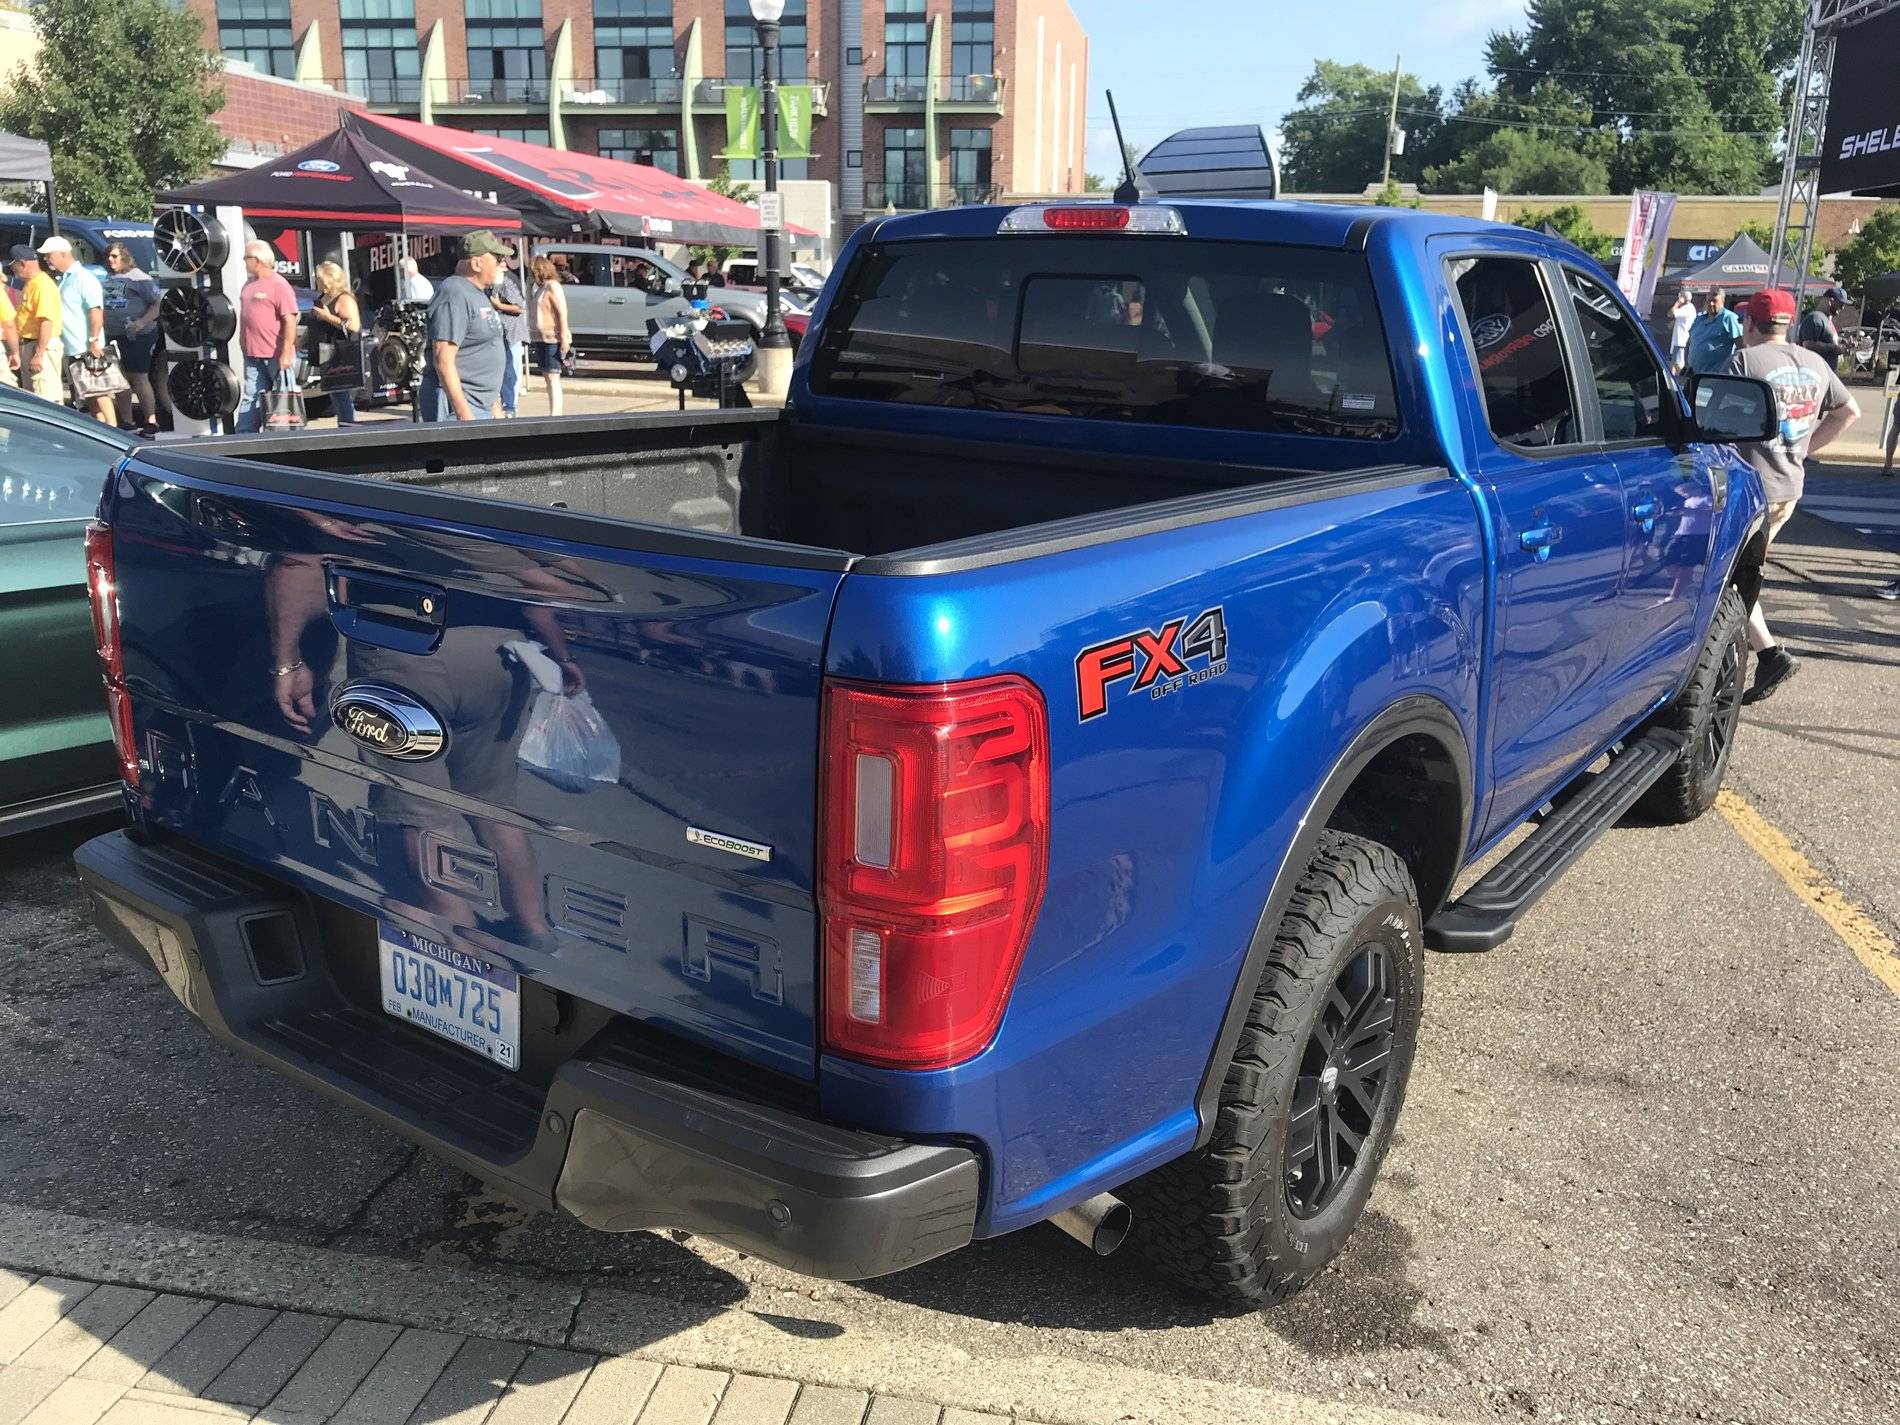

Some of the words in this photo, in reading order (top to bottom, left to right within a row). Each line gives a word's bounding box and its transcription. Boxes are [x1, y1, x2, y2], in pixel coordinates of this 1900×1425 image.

[1074, 605, 1228, 724] FX4
[1151, 680, 1183, 700] OFF
[1188, 663, 1228, 687] ROAD
[345, 706, 389, 743] Ford
[144, 720, 786, 1005] RANGER
[411, 934, 483, 974] MICHIGAN
[388, 998, 402, 1013] FEB
[411, 1007, 486, 1050] MANUFACTURER
[499, 1043, 512, 1058] 21
